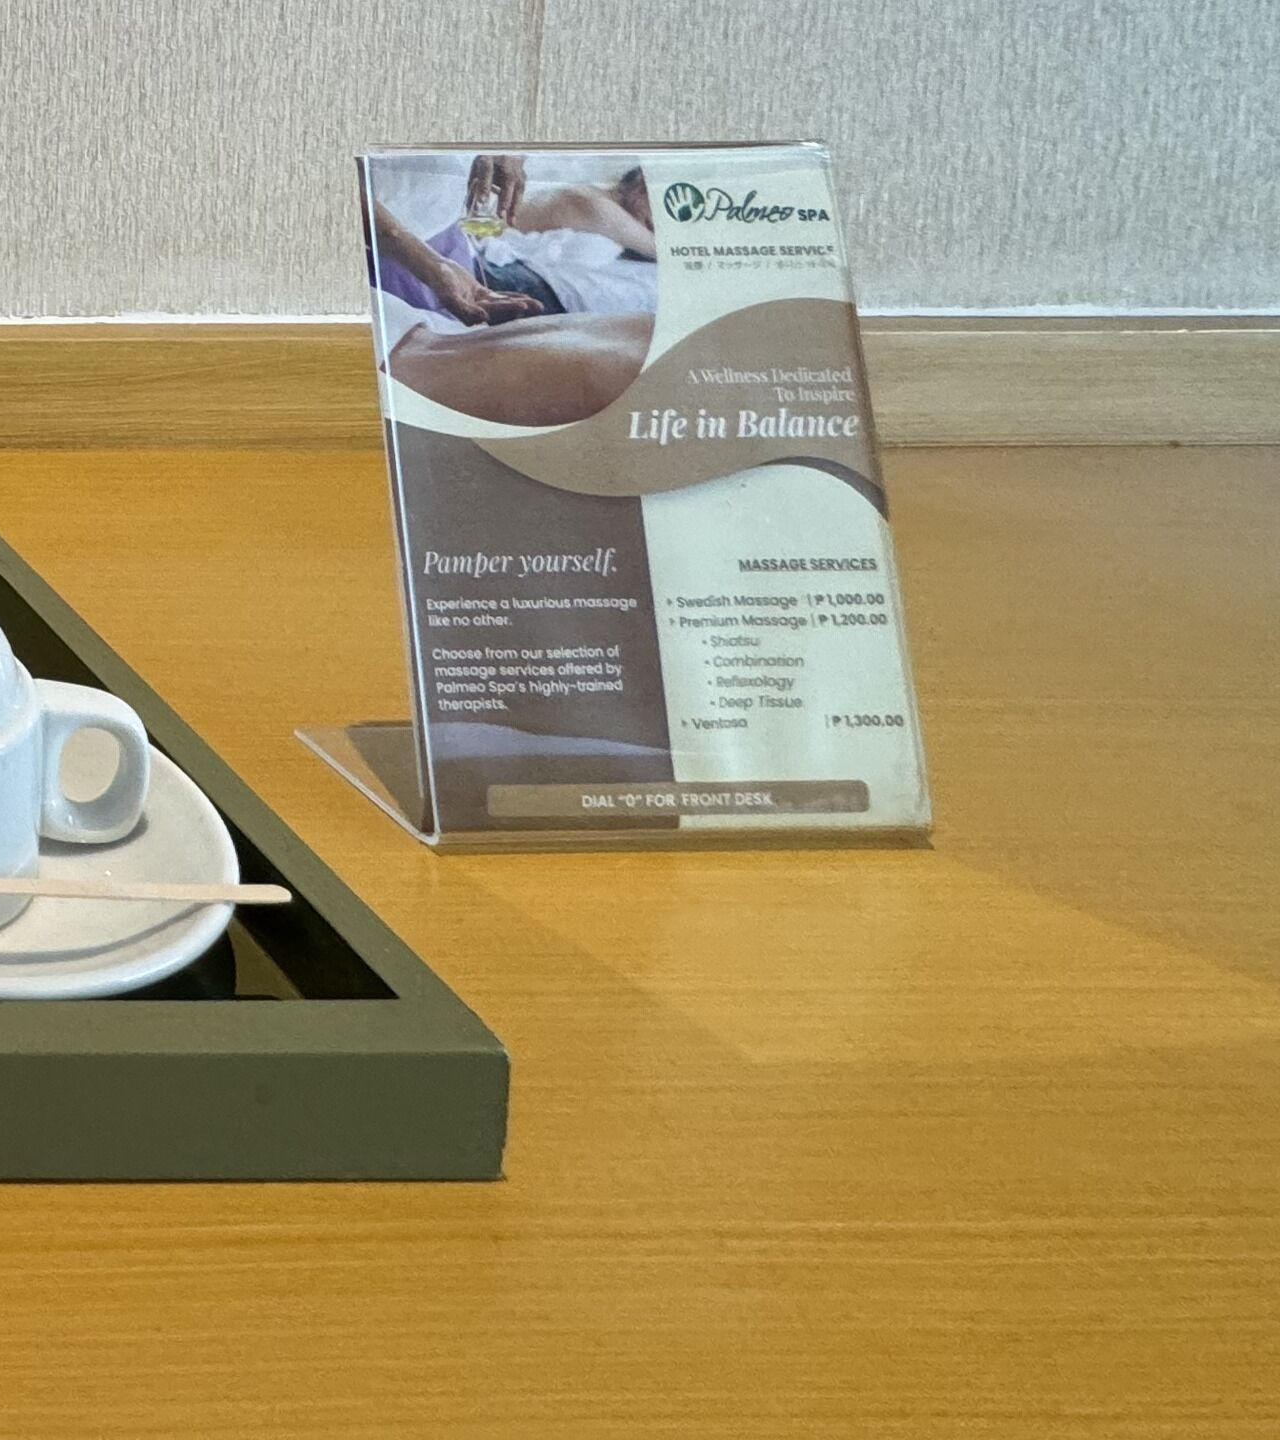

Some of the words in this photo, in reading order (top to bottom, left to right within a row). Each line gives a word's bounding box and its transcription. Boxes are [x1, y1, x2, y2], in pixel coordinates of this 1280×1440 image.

[704, 187, 795, 223] Palmeo
[798, 209, 830, 221] SPA
[670, 246, 711, 256] HOTEL
[713, 245, 777, 256] MASSAGE
[688, 369, 700, 384] A
[701, 368, 768, 384] Wellness
[770, 366, 853, 384] Dedicated
[773, 386, 796, 402] To
[798, 386, 855, 405] Inspire
[628, 409, 688, 445] Life
[696, 409, 727, 439] in
[736, 408, 860, 438] Balance
[423, 550, 514, 578] Pamper
[517, 547, 617, 577] yourself.
[739, 559, 807, 572] MASSAGE
[810, 558, 878, 572] SERVICES
[426, 598, 497, 612] Experience
[500, 599, 510, 609] a
[512, 597, 571, 609] luxurious
[573, 598, 637, 611] massage
[676, 595, 731, 608] Swedish
[734, 595, 798, 610] Massage
[428, 615, 451, 626] like
[453, 617, 471, 626] no
[473, 614, 513, 626] other.
[679, 615, 739, 628] Premium
[742, 614, 808, 630] Massage
[710, 635, 760, 647] Shiatsu
[432, 648, 483, 660] Choose
[485, 646, 518, 659] from
[521, 649, 544, 659] our
[546, 645, 604, 659] selection
[607, 645, 620, 657] of
[713, 654, 805, 667] Combination
[434, 666, 497, 680] massage
[499, 665, 555, 677] services
[557, 663, 603, 676] offered
[605, 662, 622, 677] by
[436, 681, 487, 694] Palmeo
[488, 680, 526, 696] Spa's
[529, 678, 624, 697] highly-trained
[716, 674, 795, 691] Reflexology
[438, 698, 509, 713] therapists.
[719, 696, 753, 710] Deep
[758, 694, 802, 708] Tissue
[690, 717, 748, 729] Ventosa
[844, 714, 905, 729] 1,300.00
[581, 795, 615, 808] DIAL
[645, 794, 677, 808] FOR
[680, 792, 731, 807] FRONT
[734, 792, 773, 806] DESK
